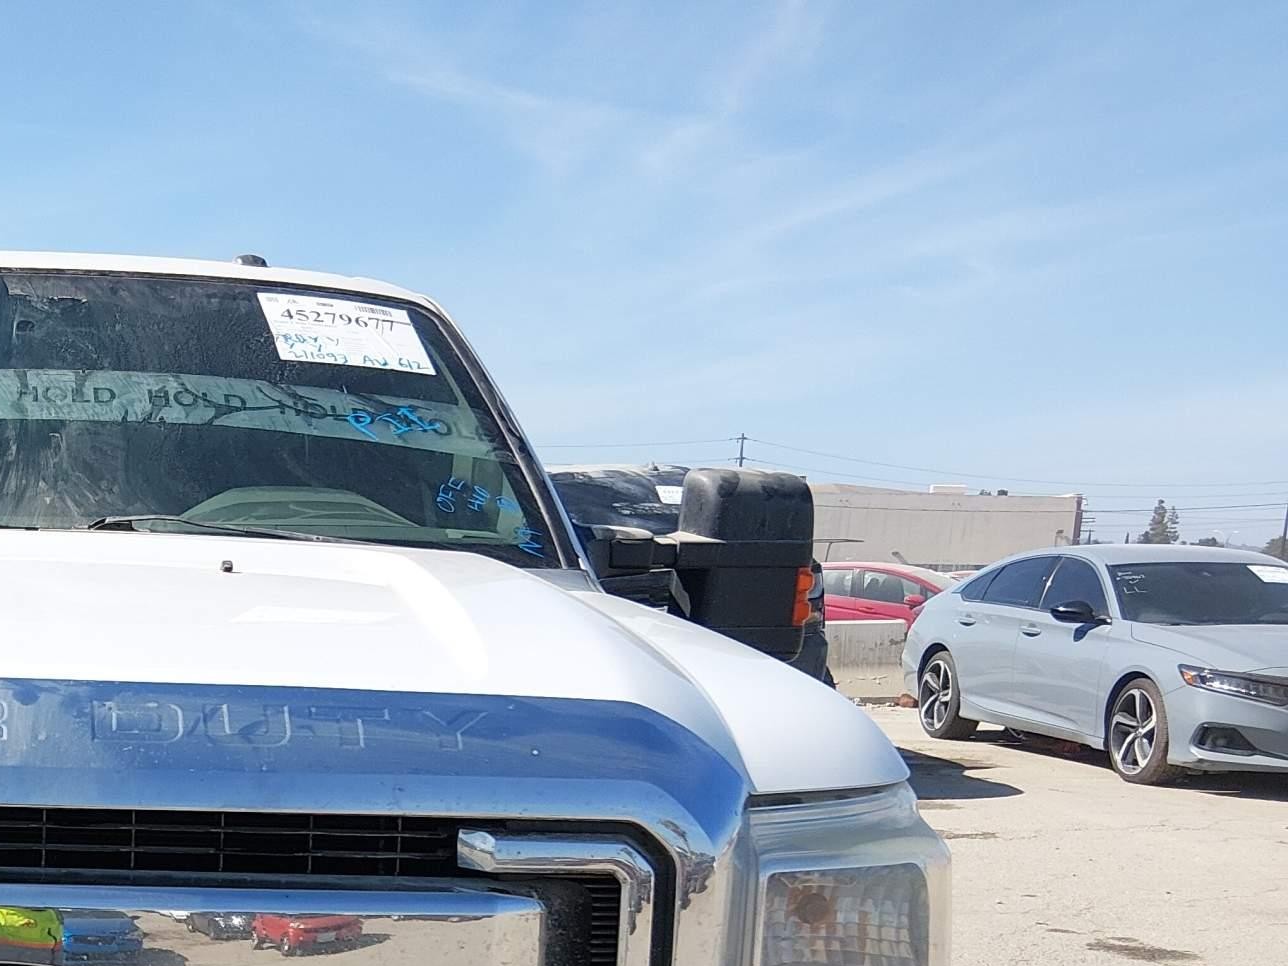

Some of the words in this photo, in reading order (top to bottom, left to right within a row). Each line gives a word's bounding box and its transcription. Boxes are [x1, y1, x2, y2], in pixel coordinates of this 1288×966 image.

[281, 309, 394, 331] 45279677
[17, 386, 116, 403] HOLD
[148, 388, 247, 411] HOLD
[91, 699, 488, 751] DUTY
